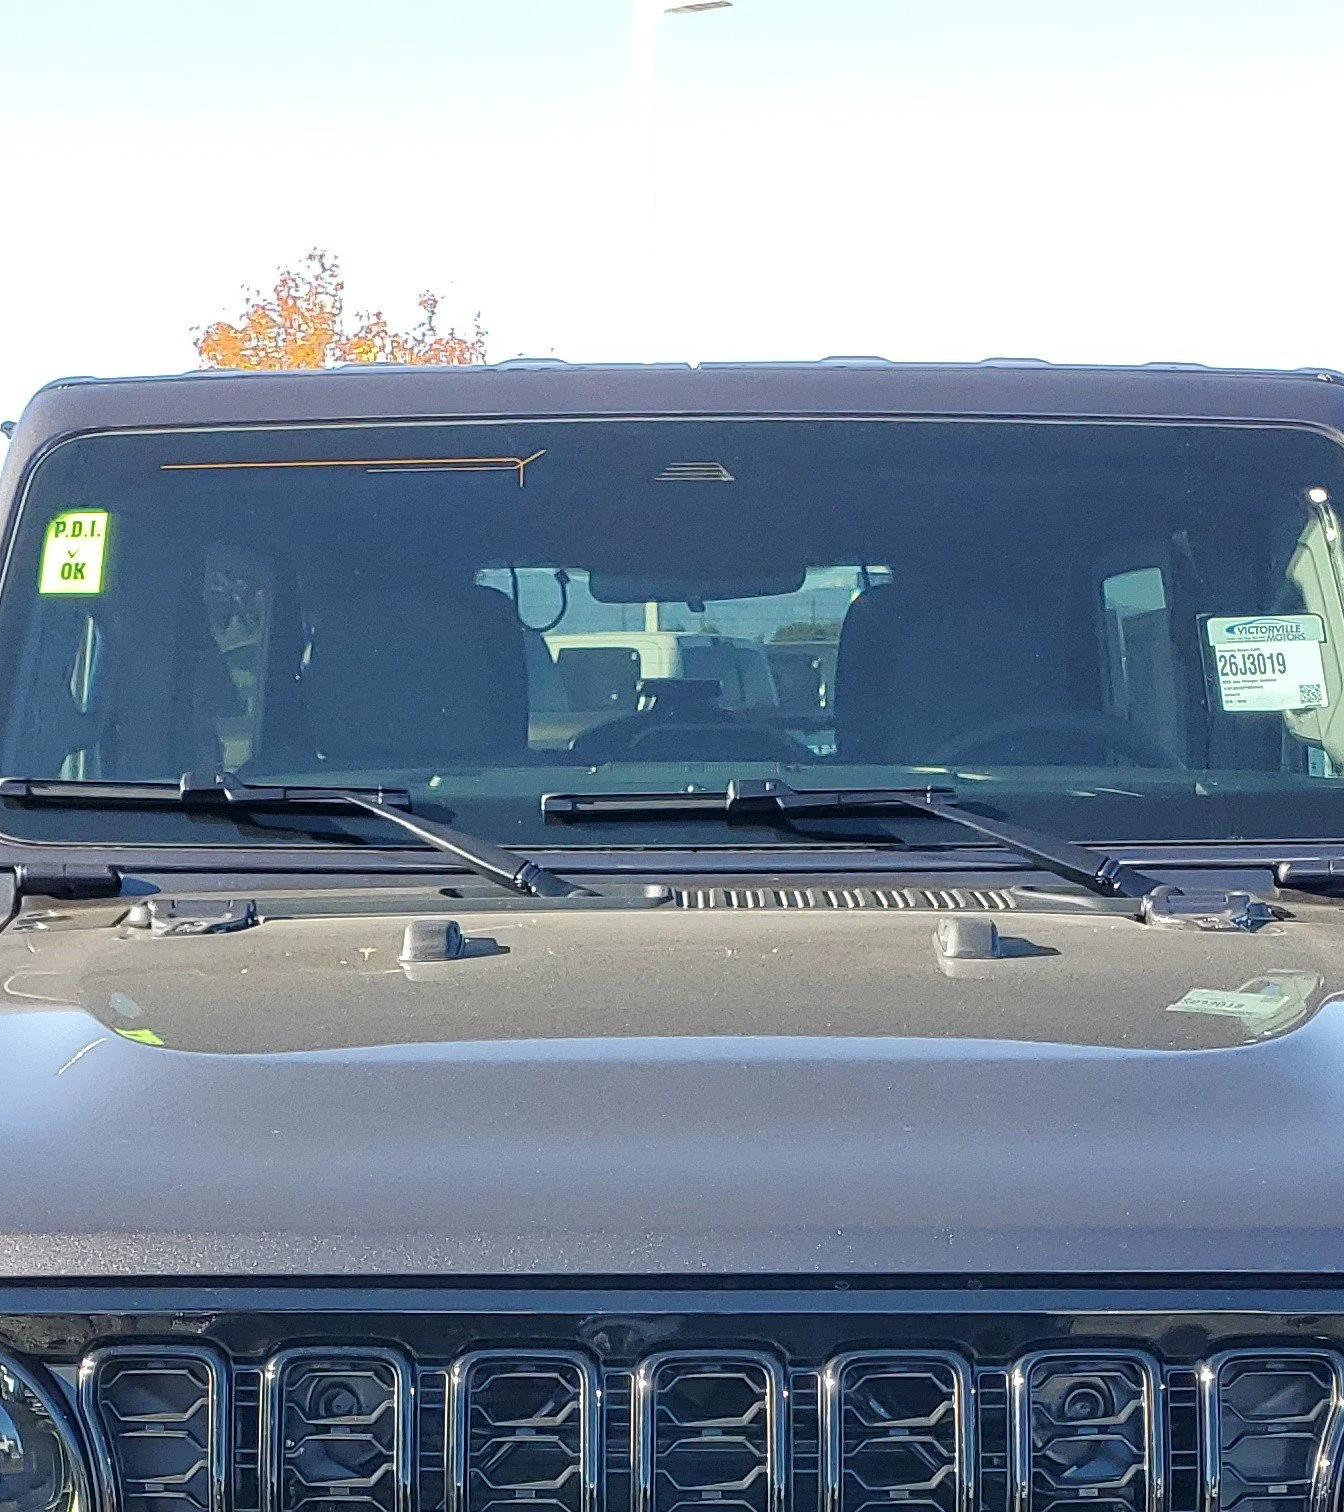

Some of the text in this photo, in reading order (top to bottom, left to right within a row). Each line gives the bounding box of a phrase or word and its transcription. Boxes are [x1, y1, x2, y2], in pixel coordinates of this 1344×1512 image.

[54, 520, 101, 538] P.D.I.
[60, 562, 86, 580] OK
[1237, 624, 1302, 636] VICTORVILLE
[1266, 633, 1306, 642] MOTORS
[1218, 652, 1287, 677] 26J3019
